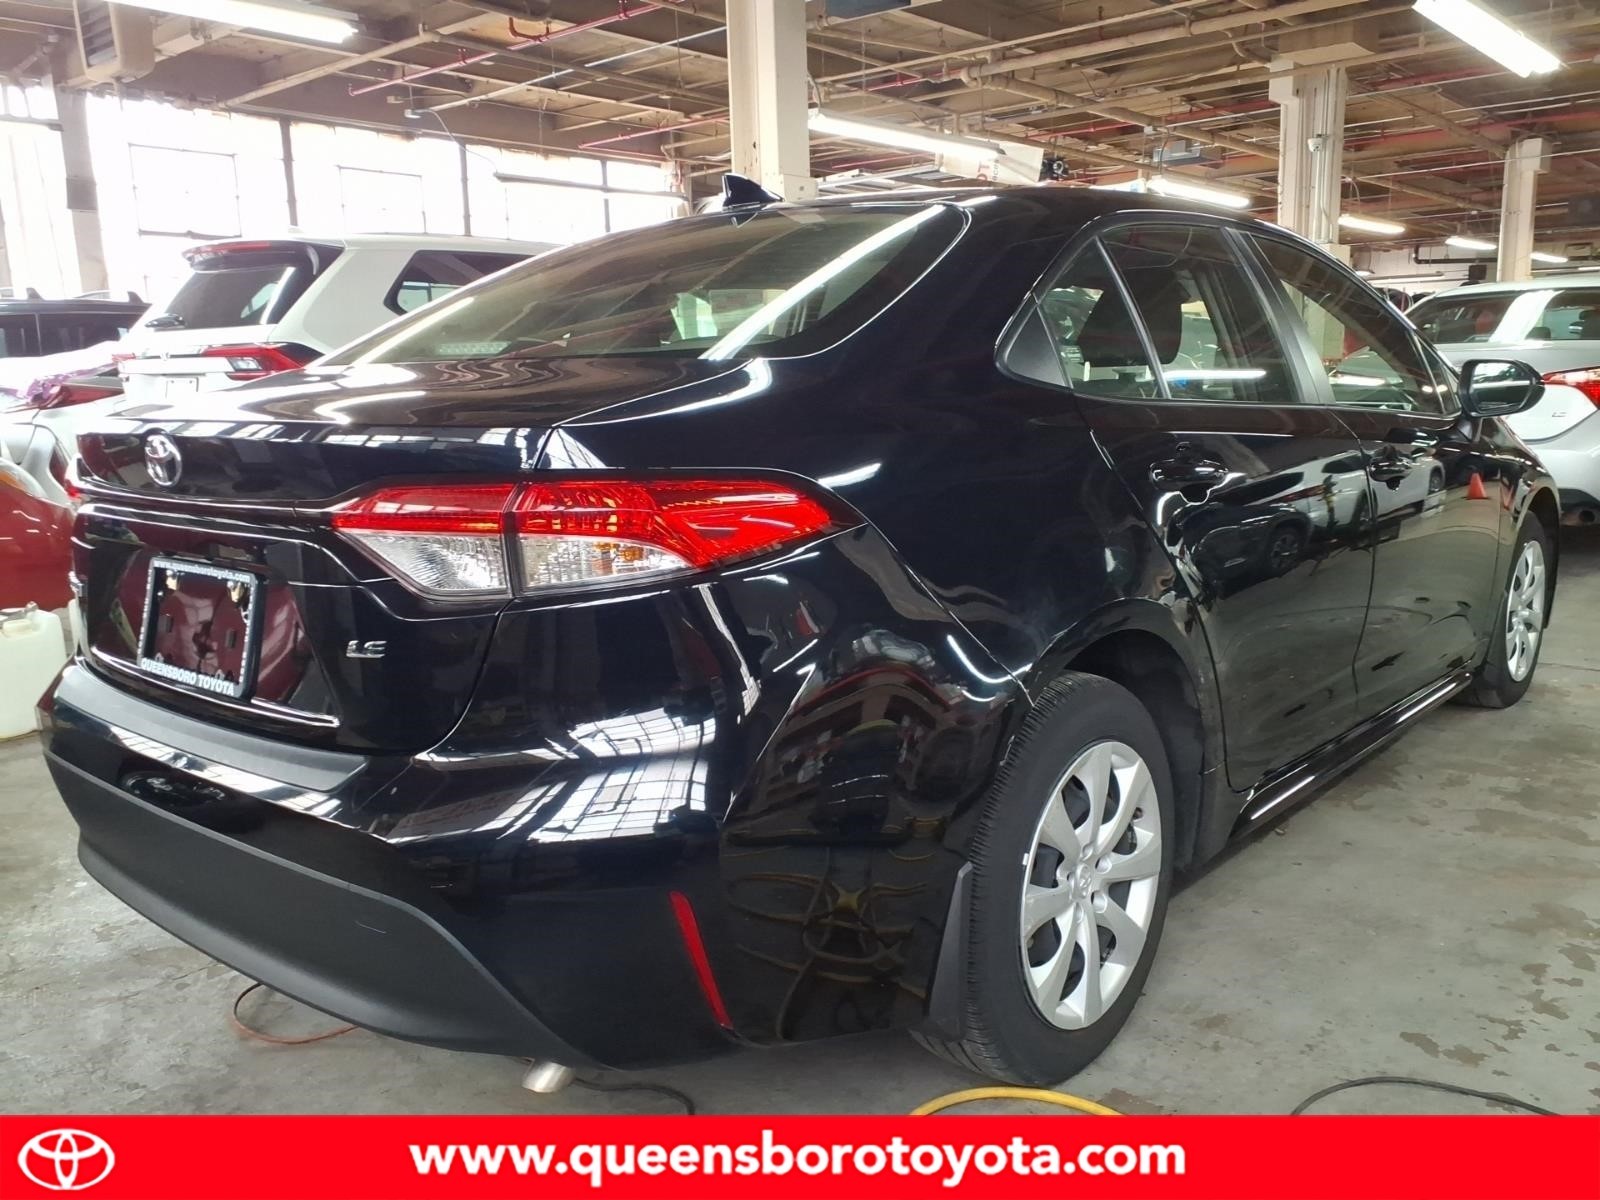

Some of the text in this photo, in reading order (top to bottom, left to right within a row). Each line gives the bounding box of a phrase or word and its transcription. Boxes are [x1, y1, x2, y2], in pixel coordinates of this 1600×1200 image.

[345, 640, 387, 659] LE
[140, 657, 235, 696] QUEENSBORO TOYOTA
